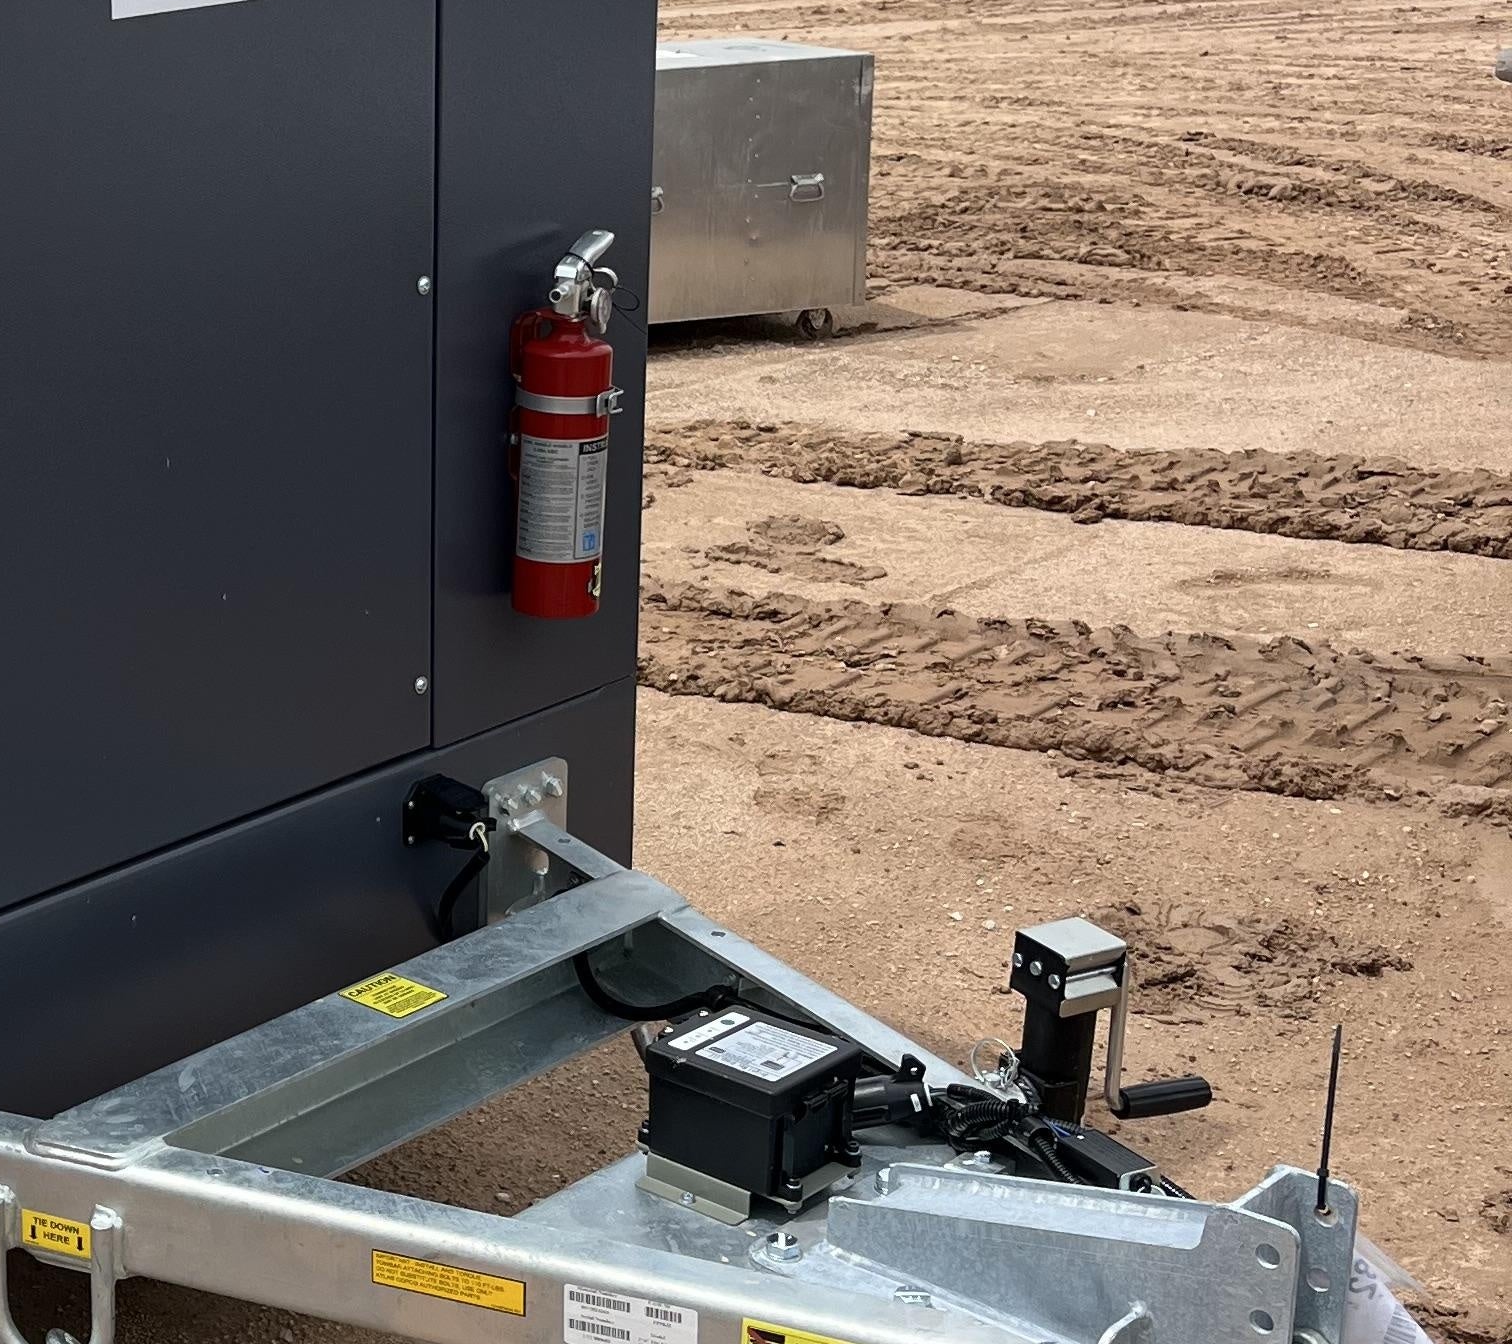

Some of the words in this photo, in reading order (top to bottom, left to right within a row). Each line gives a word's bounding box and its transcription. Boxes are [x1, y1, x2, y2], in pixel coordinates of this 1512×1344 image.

[348, 975, 397, 997] CAUTION
[33, 1216, 47, 1227] TIE
[50, 1221, 79, 1235] DOWN
[43, 1231, 70, 1245] HERE
